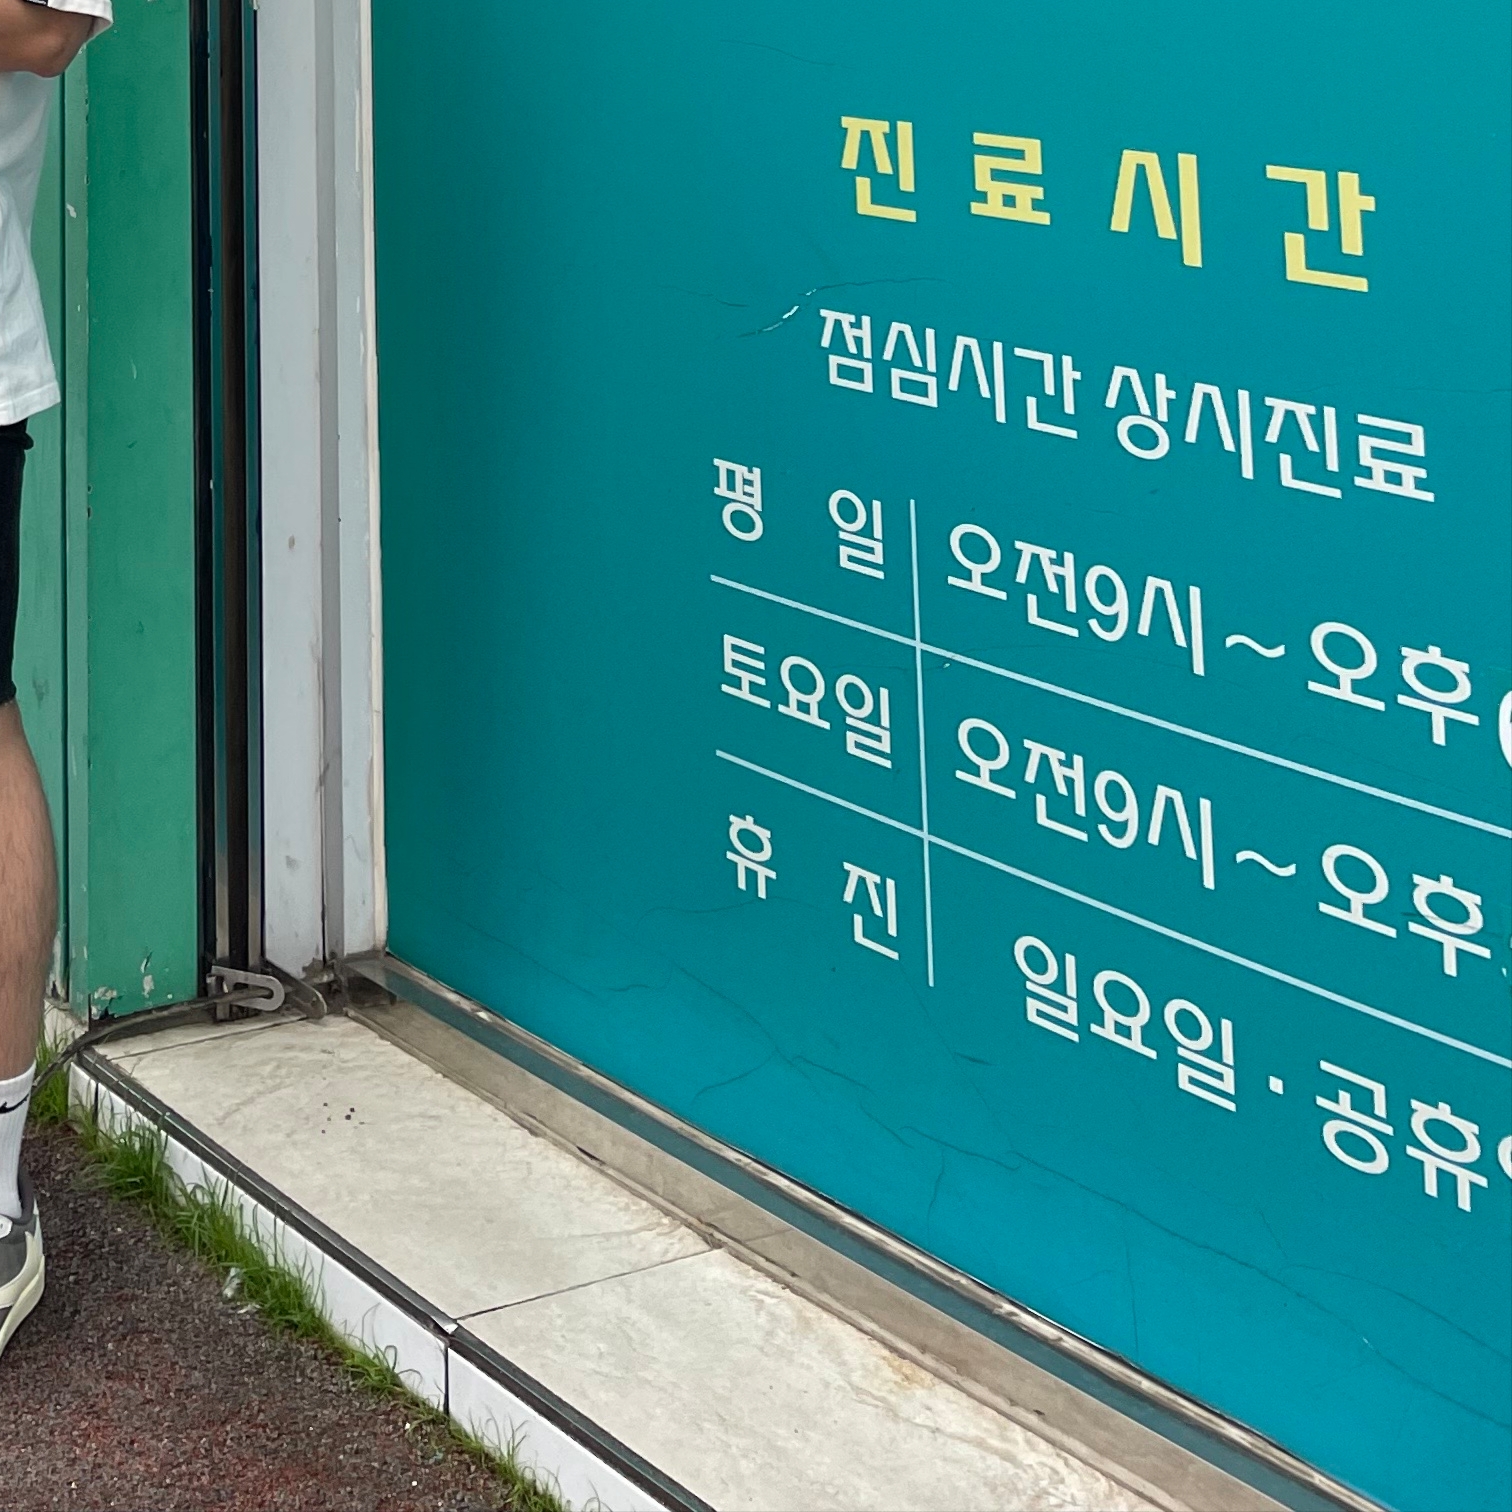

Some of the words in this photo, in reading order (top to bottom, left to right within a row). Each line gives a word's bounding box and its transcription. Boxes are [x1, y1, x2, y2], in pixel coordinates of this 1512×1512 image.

[841, 115, 1376, 292] 진료시간
[819, 308, 1082, 439] 점심시간
[1104, 365, 1435, 503] 상시진료
[712, 458, 886, 580] 평일
[720, 633, 893, 769] 토요일
[726, 813, 899, 960] 휴진
